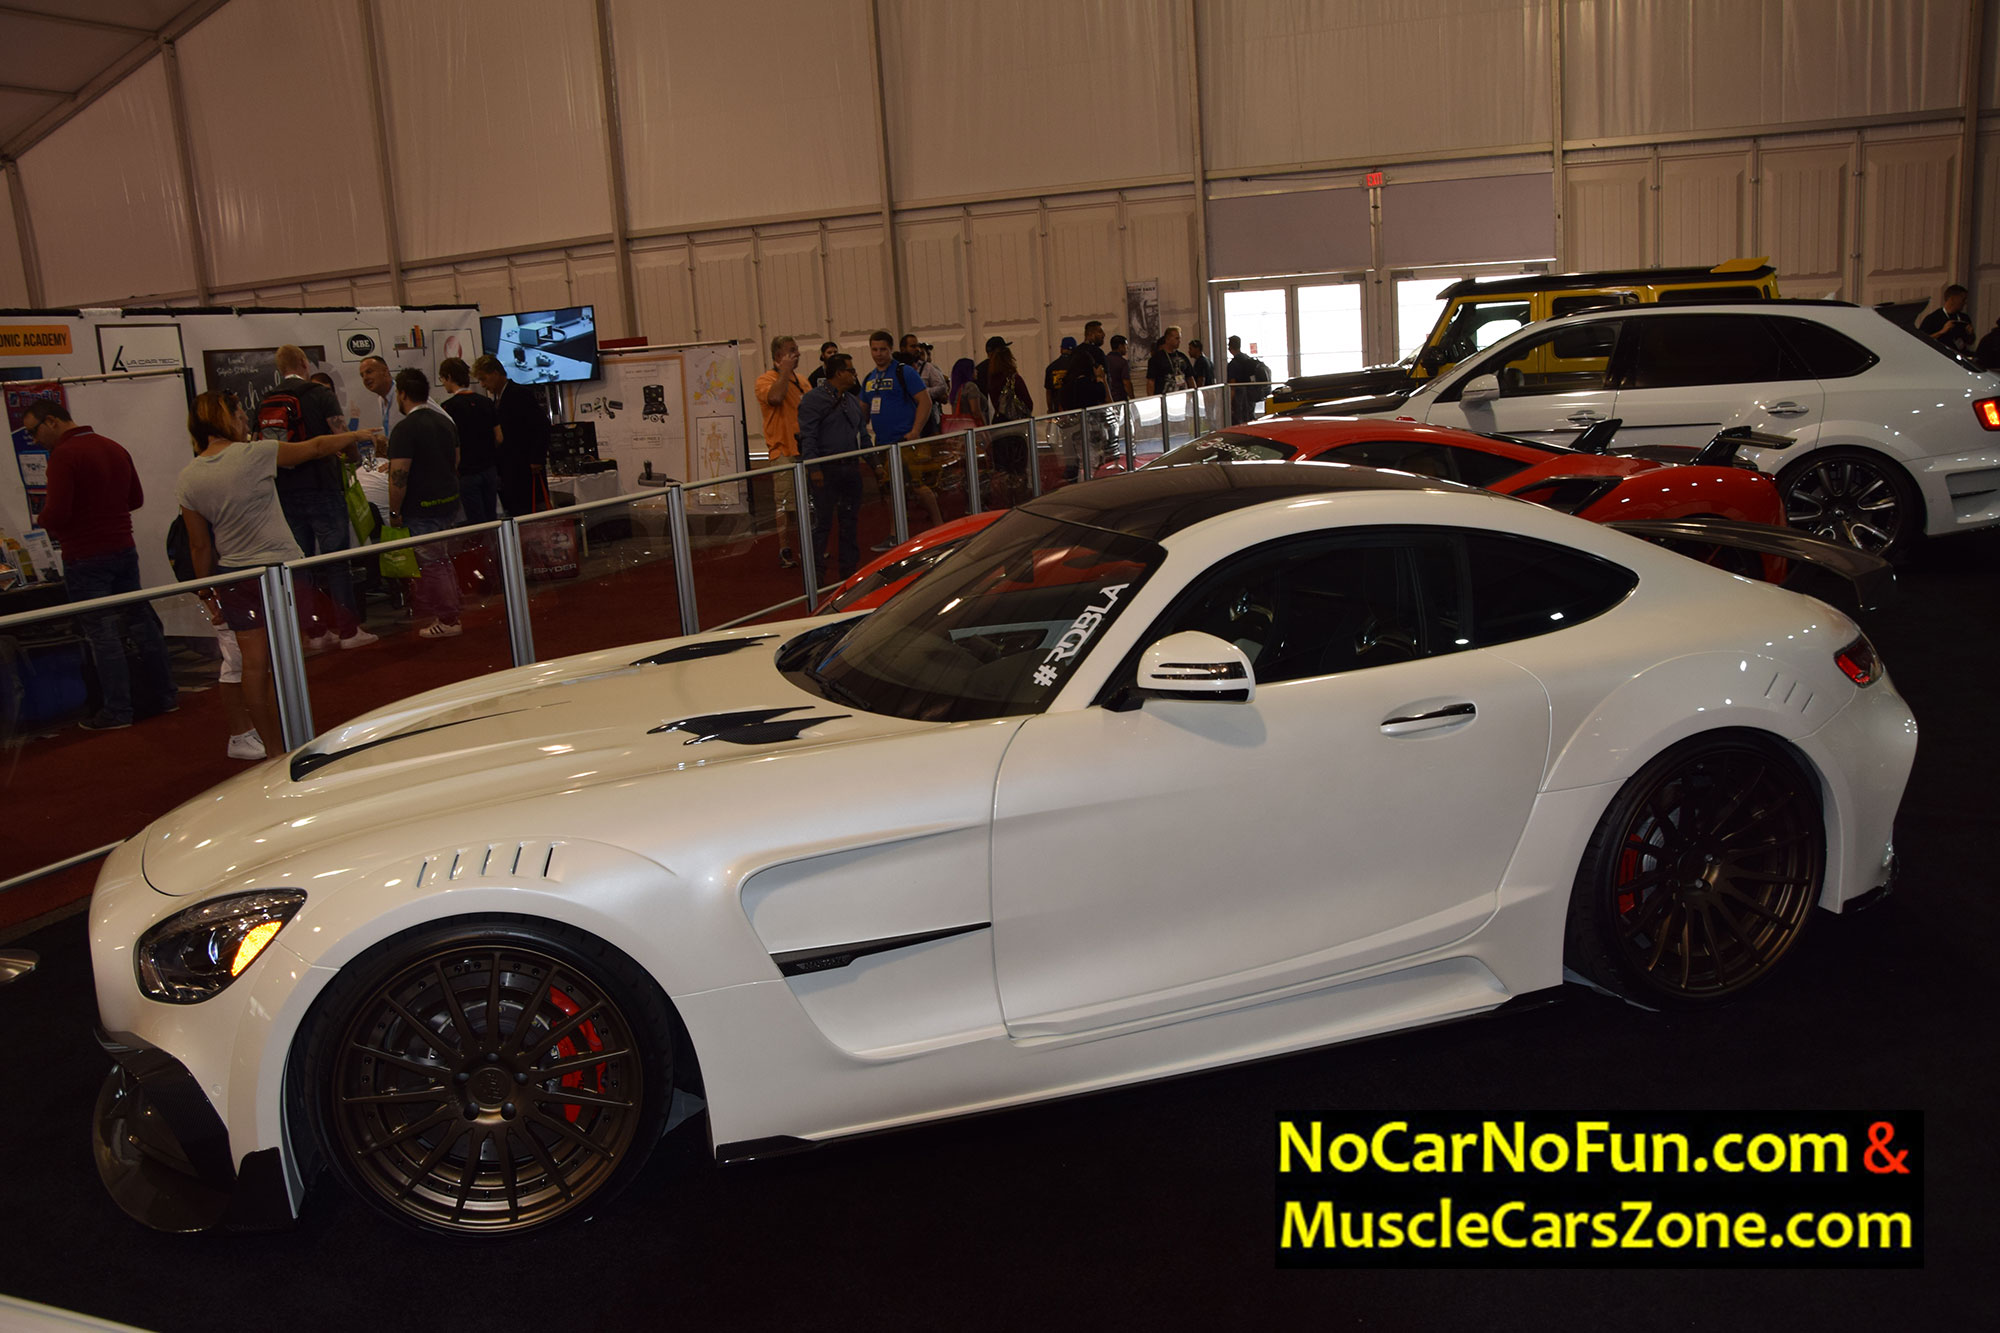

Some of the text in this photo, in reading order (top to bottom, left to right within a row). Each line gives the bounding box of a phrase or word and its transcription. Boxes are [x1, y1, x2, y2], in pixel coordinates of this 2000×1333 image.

[1366, 172, 1383, 187] EXIT
[24, 333, 67, 347] ACADEMY
[1032, 583, 1130, 687] #RDBLA
